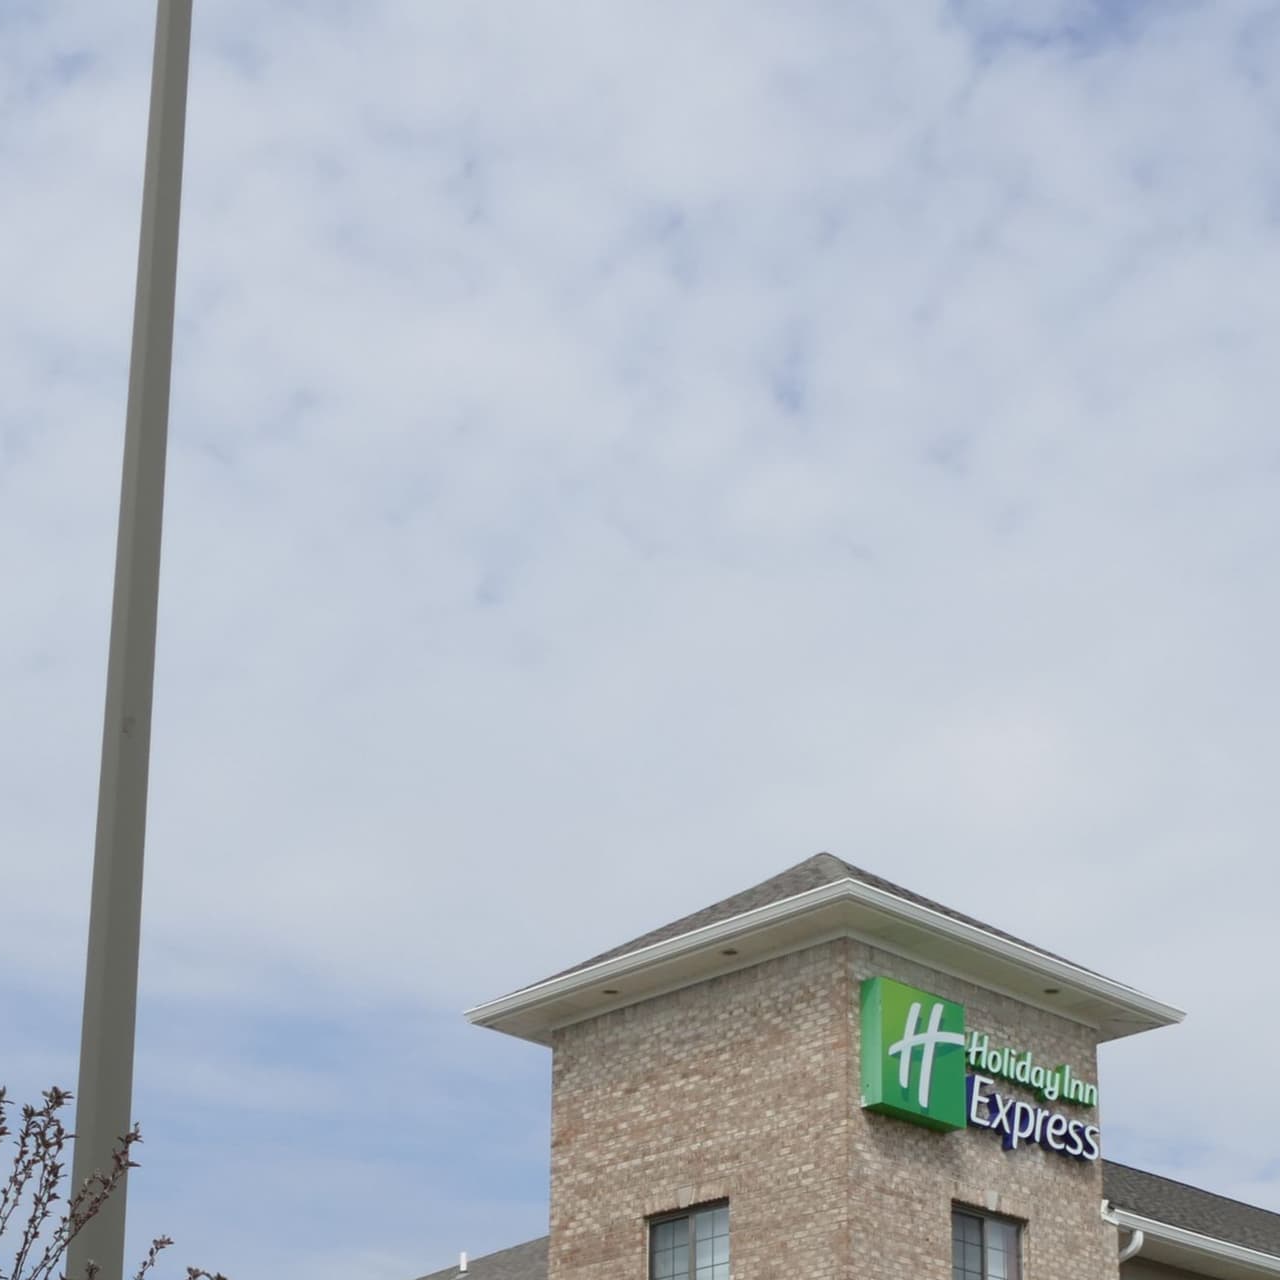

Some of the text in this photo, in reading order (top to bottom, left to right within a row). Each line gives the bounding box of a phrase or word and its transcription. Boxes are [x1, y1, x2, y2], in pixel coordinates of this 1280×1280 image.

[968, 1031, 1098, 1106] Holiday Inn
[970, 1074, 1100, 1161] Express
